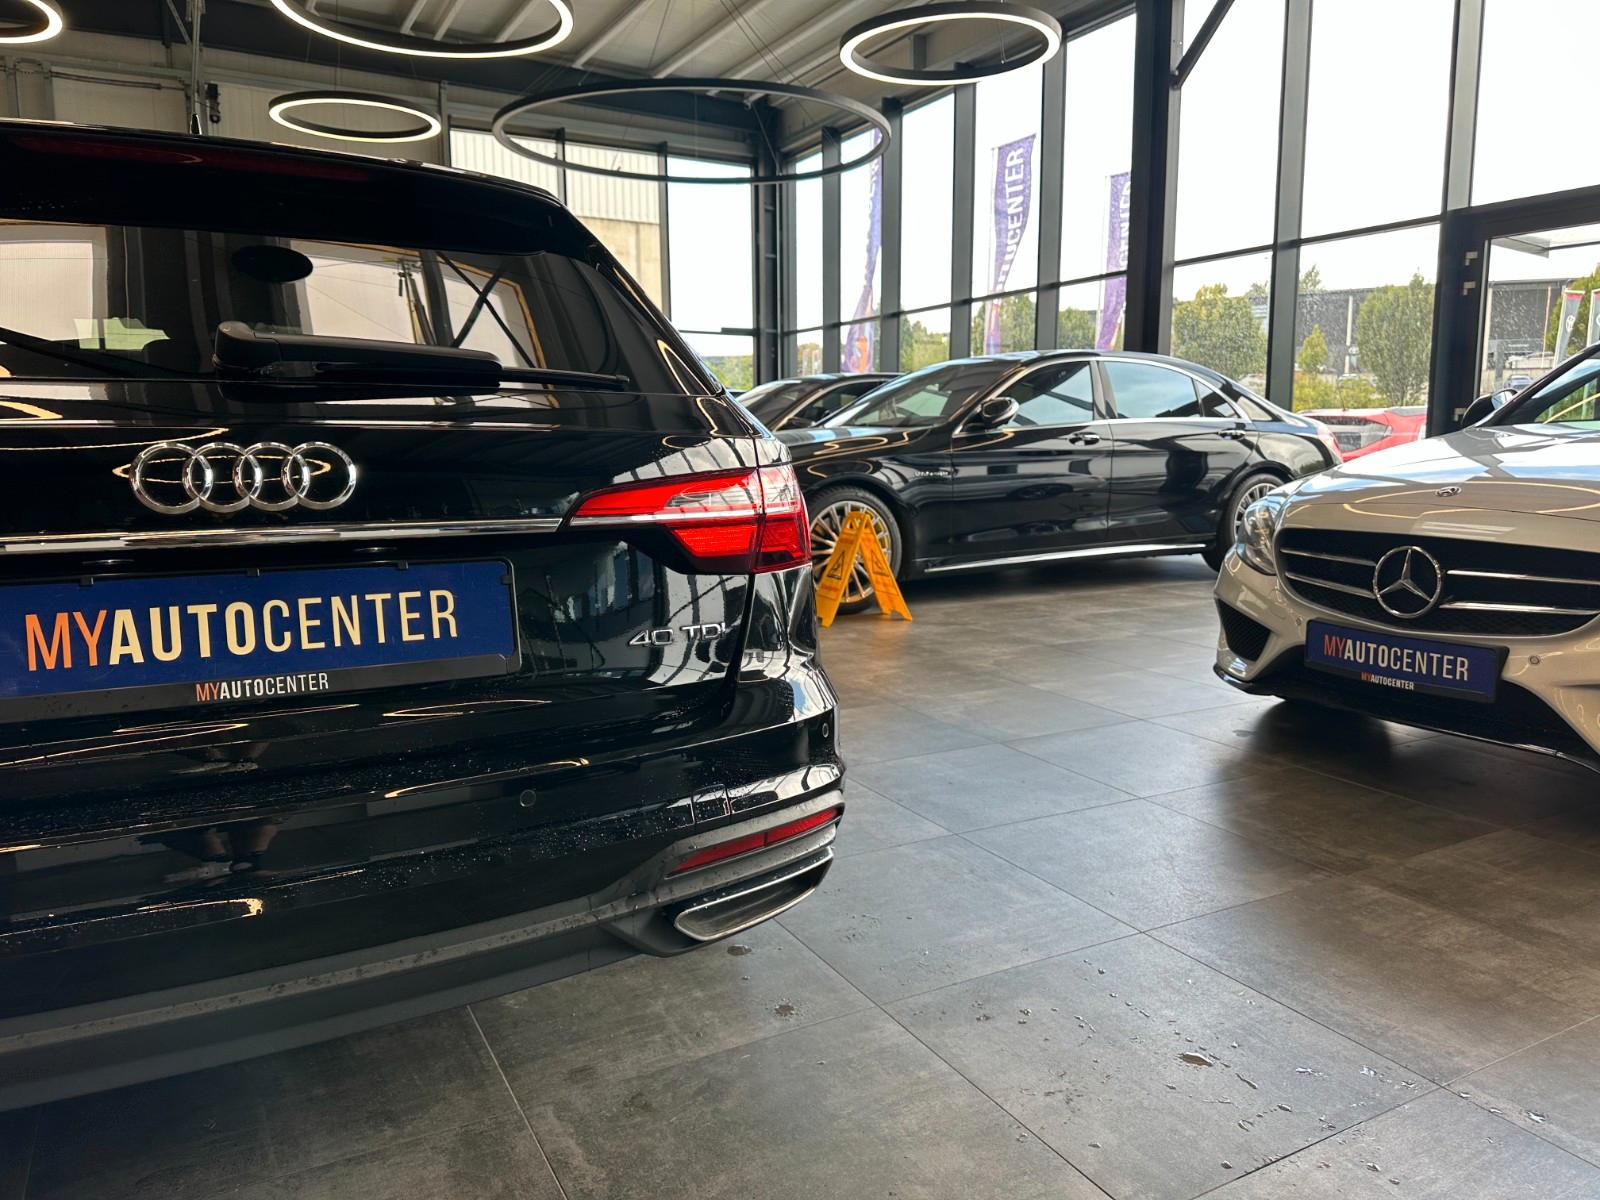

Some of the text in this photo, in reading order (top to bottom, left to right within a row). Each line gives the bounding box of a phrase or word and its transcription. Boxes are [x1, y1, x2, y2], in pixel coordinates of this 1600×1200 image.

[26, 589, 458, 671] MYAUTOCENTER
[629, 622, 727, 646] 40 TDI
[1323, 634, 1469, 681] MYAUTOCENTER
[195, 673, 329, 701] MYAUTOCENTER
[1360, 672, 1415, 690] MYAUTOCENTER
